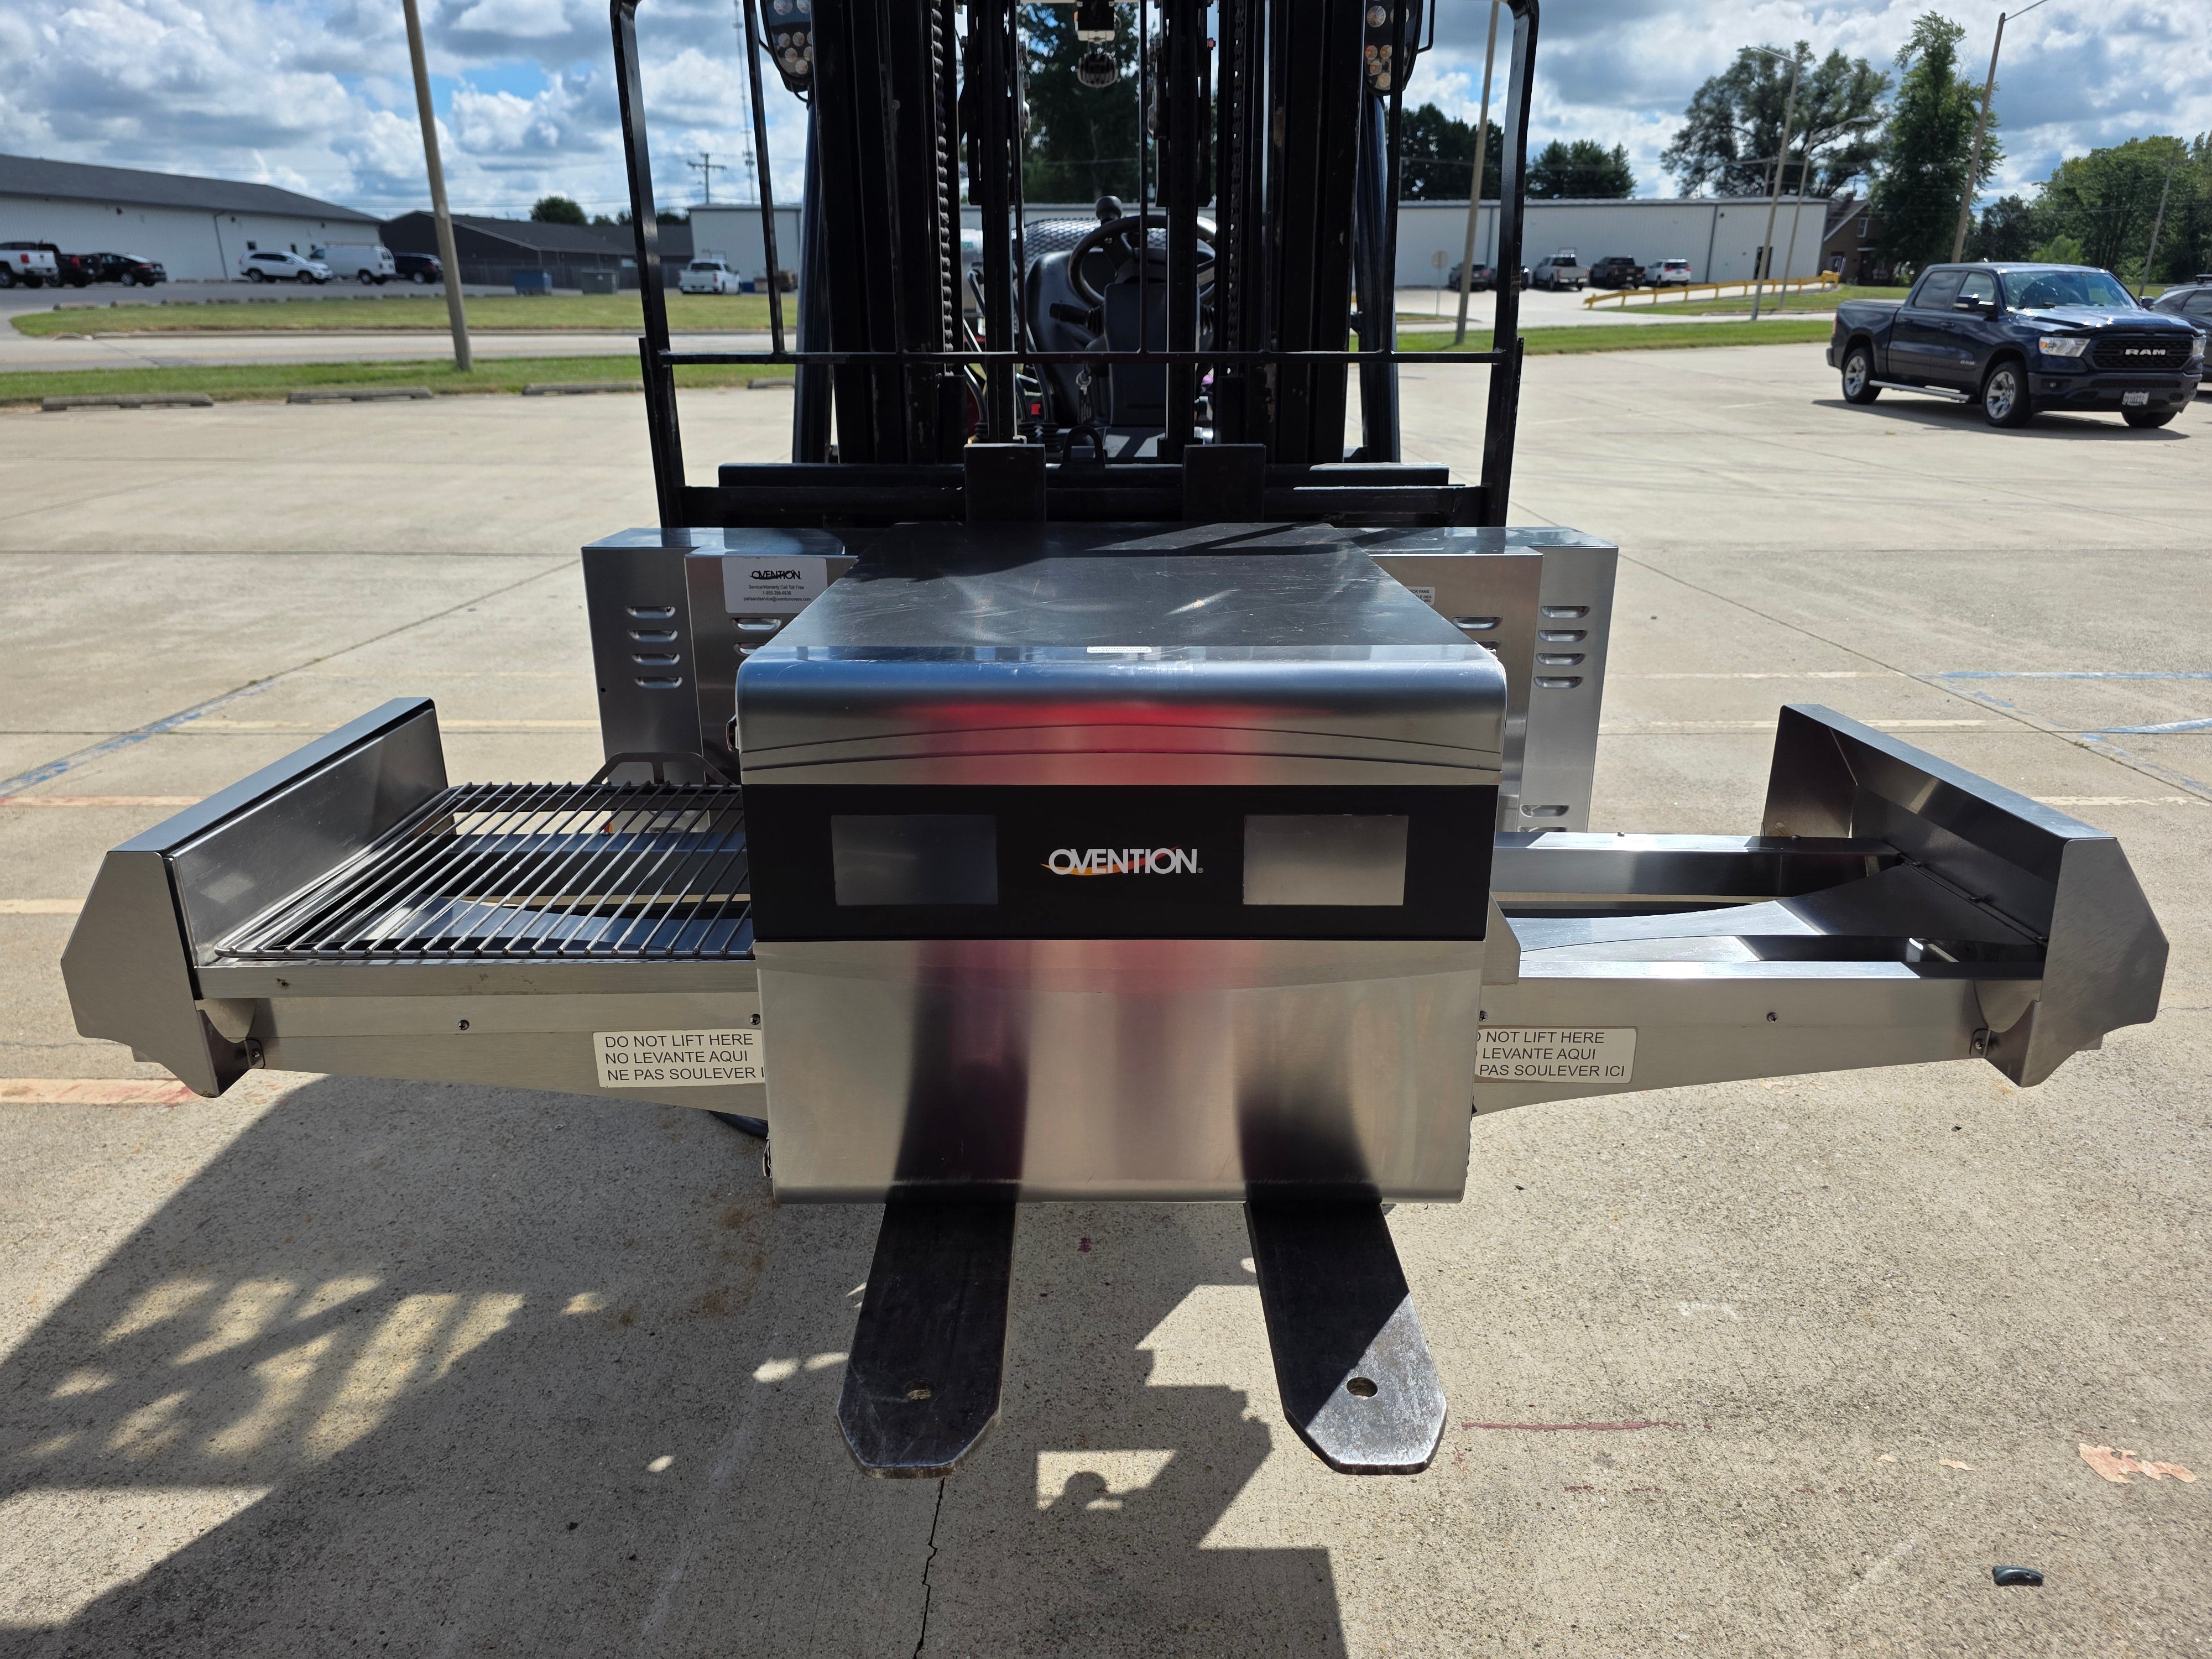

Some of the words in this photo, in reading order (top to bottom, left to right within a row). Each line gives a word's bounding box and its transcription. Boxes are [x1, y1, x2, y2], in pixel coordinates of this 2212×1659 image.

[605, 1036, 629, 1048] DO
[634, 1035, 667, 1047] NOT
[672, 1035, 705, 1046] LIFT
[709, 1034, 754, 1046] HERE
[1486, 1031, 1520, 1042] NOT
[1524, 1031, 1557, 1043] LIFT
[1561, 1032, 1605, 1044] HERE
[606, 1052, 629, 1064] NO
[634, 1051, 706, 1063] LEVANTE
[709, 1050, 748, 1062] AQUI
[1483, 1048, 1553, 1060] LEVANTE
[1557, 1048, 1595, 1060] AQUI
[607, 1070, 629, 1081] NE
[634, 1068, 664, 1080] PAS
[670, 1067, 755, 1079] SOULEVER
[1479, 1065, 1509, 1076] PAS
[1514, 1065, 1600, 1077] SOULEVER
[1605, 1066, 1625, 1077] ICI
